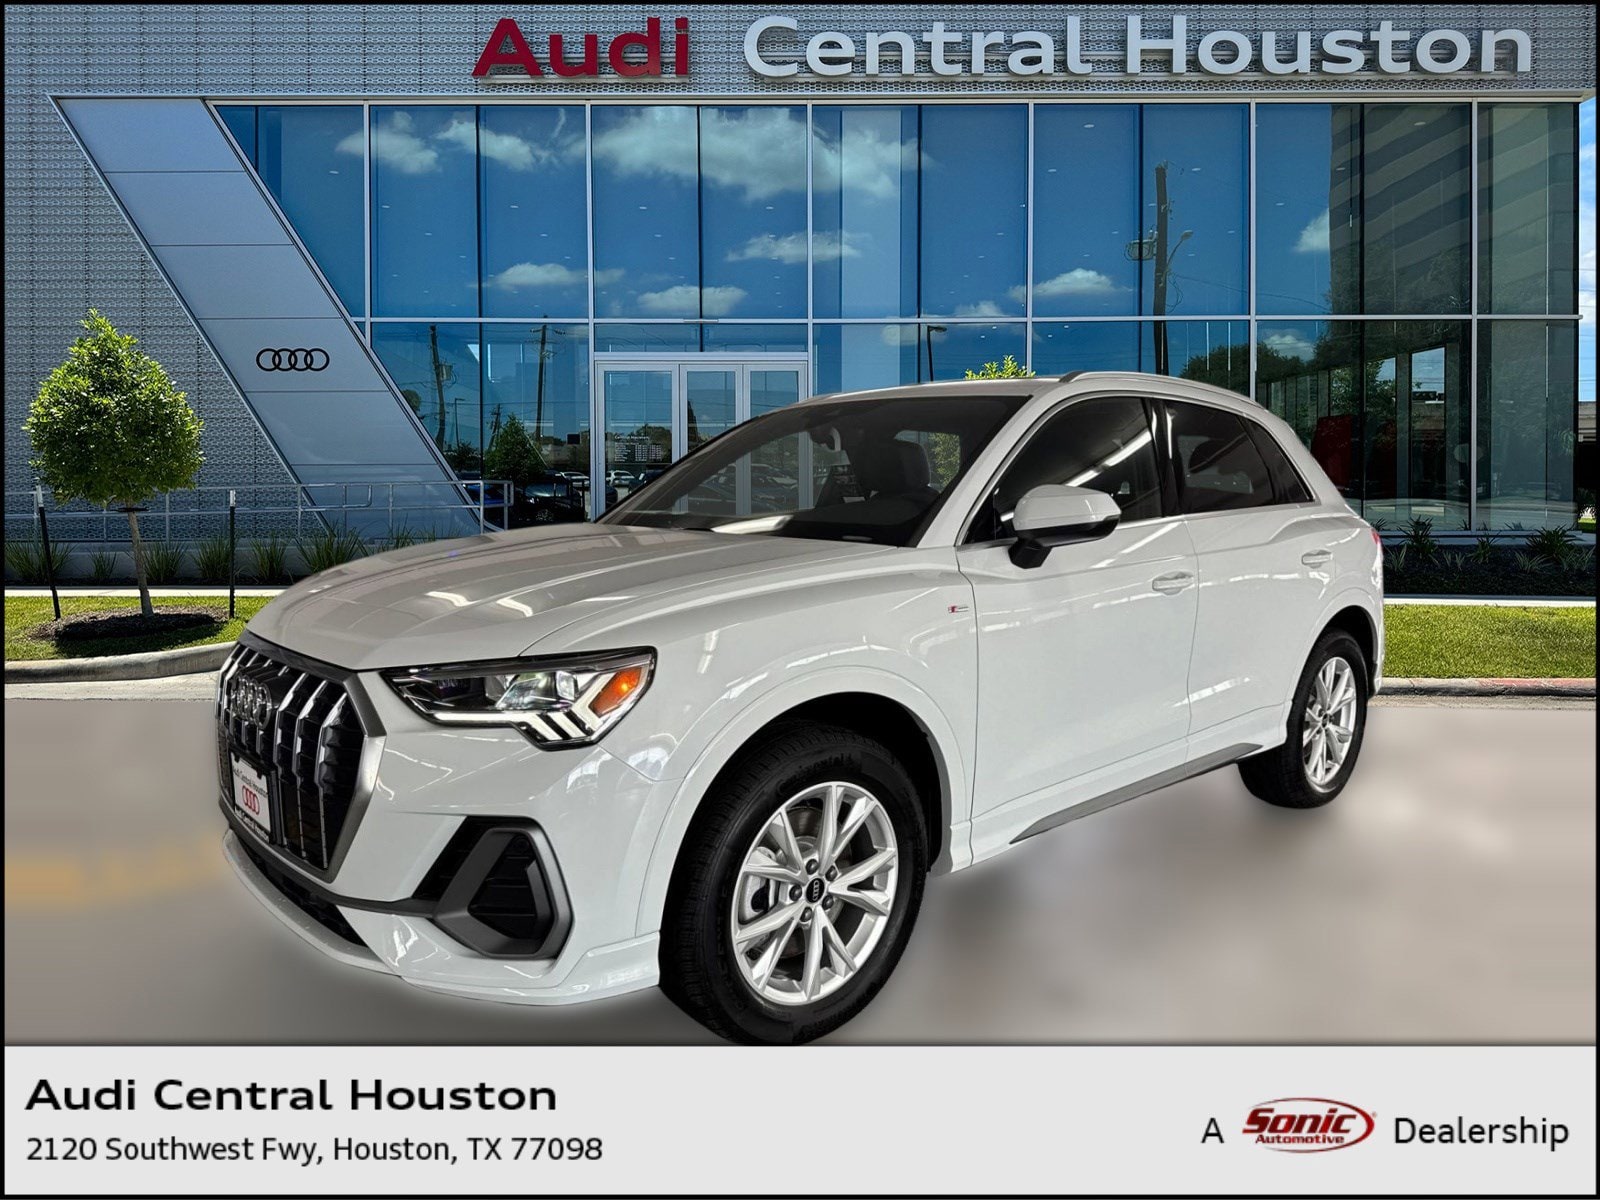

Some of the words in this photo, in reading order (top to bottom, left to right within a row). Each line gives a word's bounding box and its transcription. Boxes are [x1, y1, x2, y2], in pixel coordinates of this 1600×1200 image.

[471, 17, 689, 78] Audi
[743, 15, 1093, 78] Central
[1126, 15, 1532, 75] Houston
